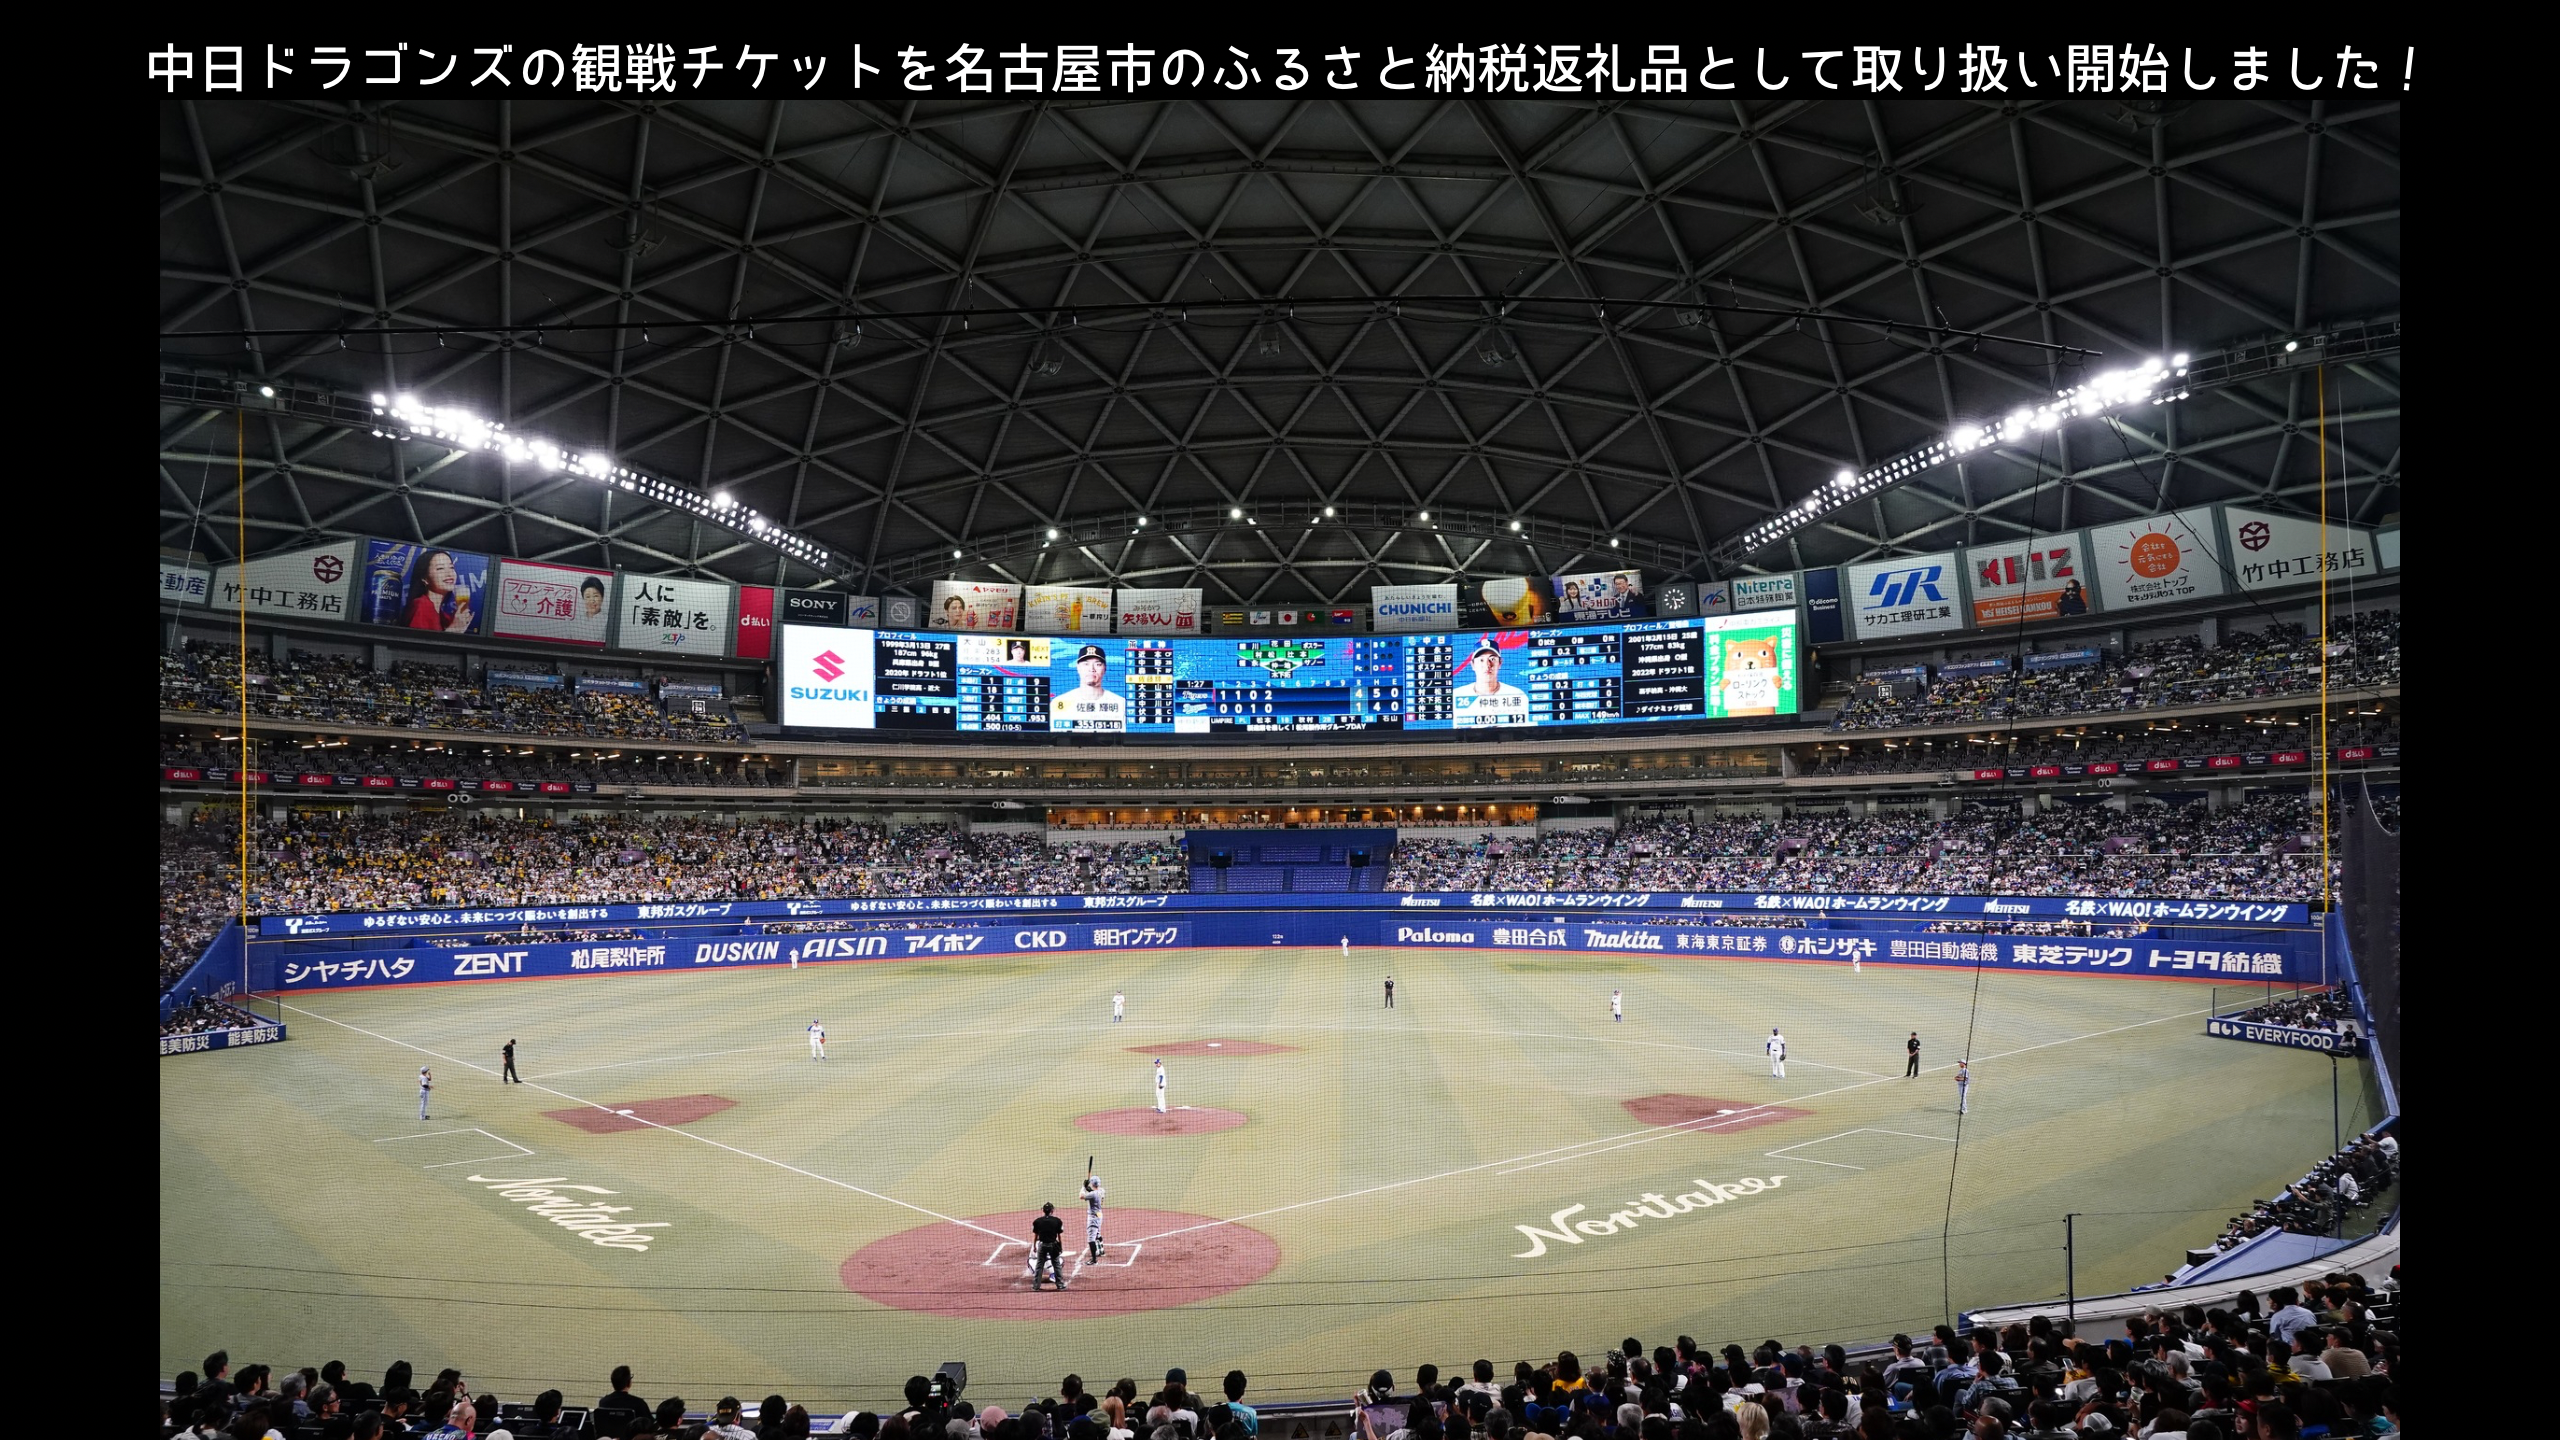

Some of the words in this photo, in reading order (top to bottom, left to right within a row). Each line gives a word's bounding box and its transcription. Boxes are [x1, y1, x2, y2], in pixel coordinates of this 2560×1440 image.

[1976, 548, 2074, 588] KEIZ
[2242, 548, 2365, 584] 竹中工務店
[507, 582, 573, 599] フロンティアの
[634, 583, 674, 603] 人に
[1737, 578, 1793, 595] Niterra
[2131, 582, 2162, 593] 株式会社
[2163, 575, 2188, 588] トップ
[2176, 586, 2195, 595] TOP
[223, 582, 342, 613] 竹中工務店
[790, 598, 838, 610] SONY
[537, 597, 573, 618] 介護
[1379, 602, 1452, 615] CHUNICHI
[1574, 609, 1631, 621] 東海テレビ
[1996, 605, 2019, 616] HEISEI
[632, 606, 716, 631] 「素敵」を。
[741, 614, 770, 627] d払い
[878, 632, 916, 640] プロフィール
[791, 687, 867, 701] SUZUKI
[1249, 690, 1258, 700] 0
[1264, 690, 1273, 700] 2
[1355, 688, 1363, 698] 4
[1373, 688, 1381, 698] 5
[1391, 687, 1399, 697] 0
[1457, 698, 1470, 706] 26
[1479, 698, 1498, 708] 仲地
[1502, 697, 1521, 707] 礼亜
[1058, 702, 1064, 710] 8
[1077, 702, 1095, 712] 佐藤
[1220, 704, 1228, 714] 0
[1235, 703, 1243, 714] 0
[1264, 703, 1273, 713] 0
[1373, 701, 1381, 711] 4
[1391, 701, 1399, 711] 0
[1075, 720, 1094, 729] .353
[1476, 716, 1496, 724] 0.00
[1512, 715, 1523, 723] 12
[638, 903, 731, 918] 東邦ガスグループ
[1084, 896, 1167, 908] 東邦ガスグループ
[1984, 898, 2030, 914] MEITETSU
[904, 934, 985, 953] アイホン
[1014, 931, 1067, 949] CKD
[1093, 927, 1178, 946] 朝日インテック
[1398, 927, 1475, 944] Paloma
[1492, 928, 1567, 947] 豊田合成
[1676, 933, 1768, 952] 東海東京証券
[802, 936, 888, 959] AISIN
[1798, 936, 1878, 957] ホシザキ
[1890, 939, 1998, 962] 豊田自動織機
[2013, 944, 2133, 967] 東芝テック
[454, 952, 529, 975] ZENT
[571, 945, 666, 969] 松尾製作所
[2149, 949, 2283, 975] トヨタ紡織
[160, 1035, 210, 1055] 能美防災
[227, 1027, 279, 1047] 能美防災
[2246, 1026, 2333, 1050] EVERYFOOD
[467, 1174, 672, 1252] Noritake
[1511, 1175, 1789, 1258] Noritake
